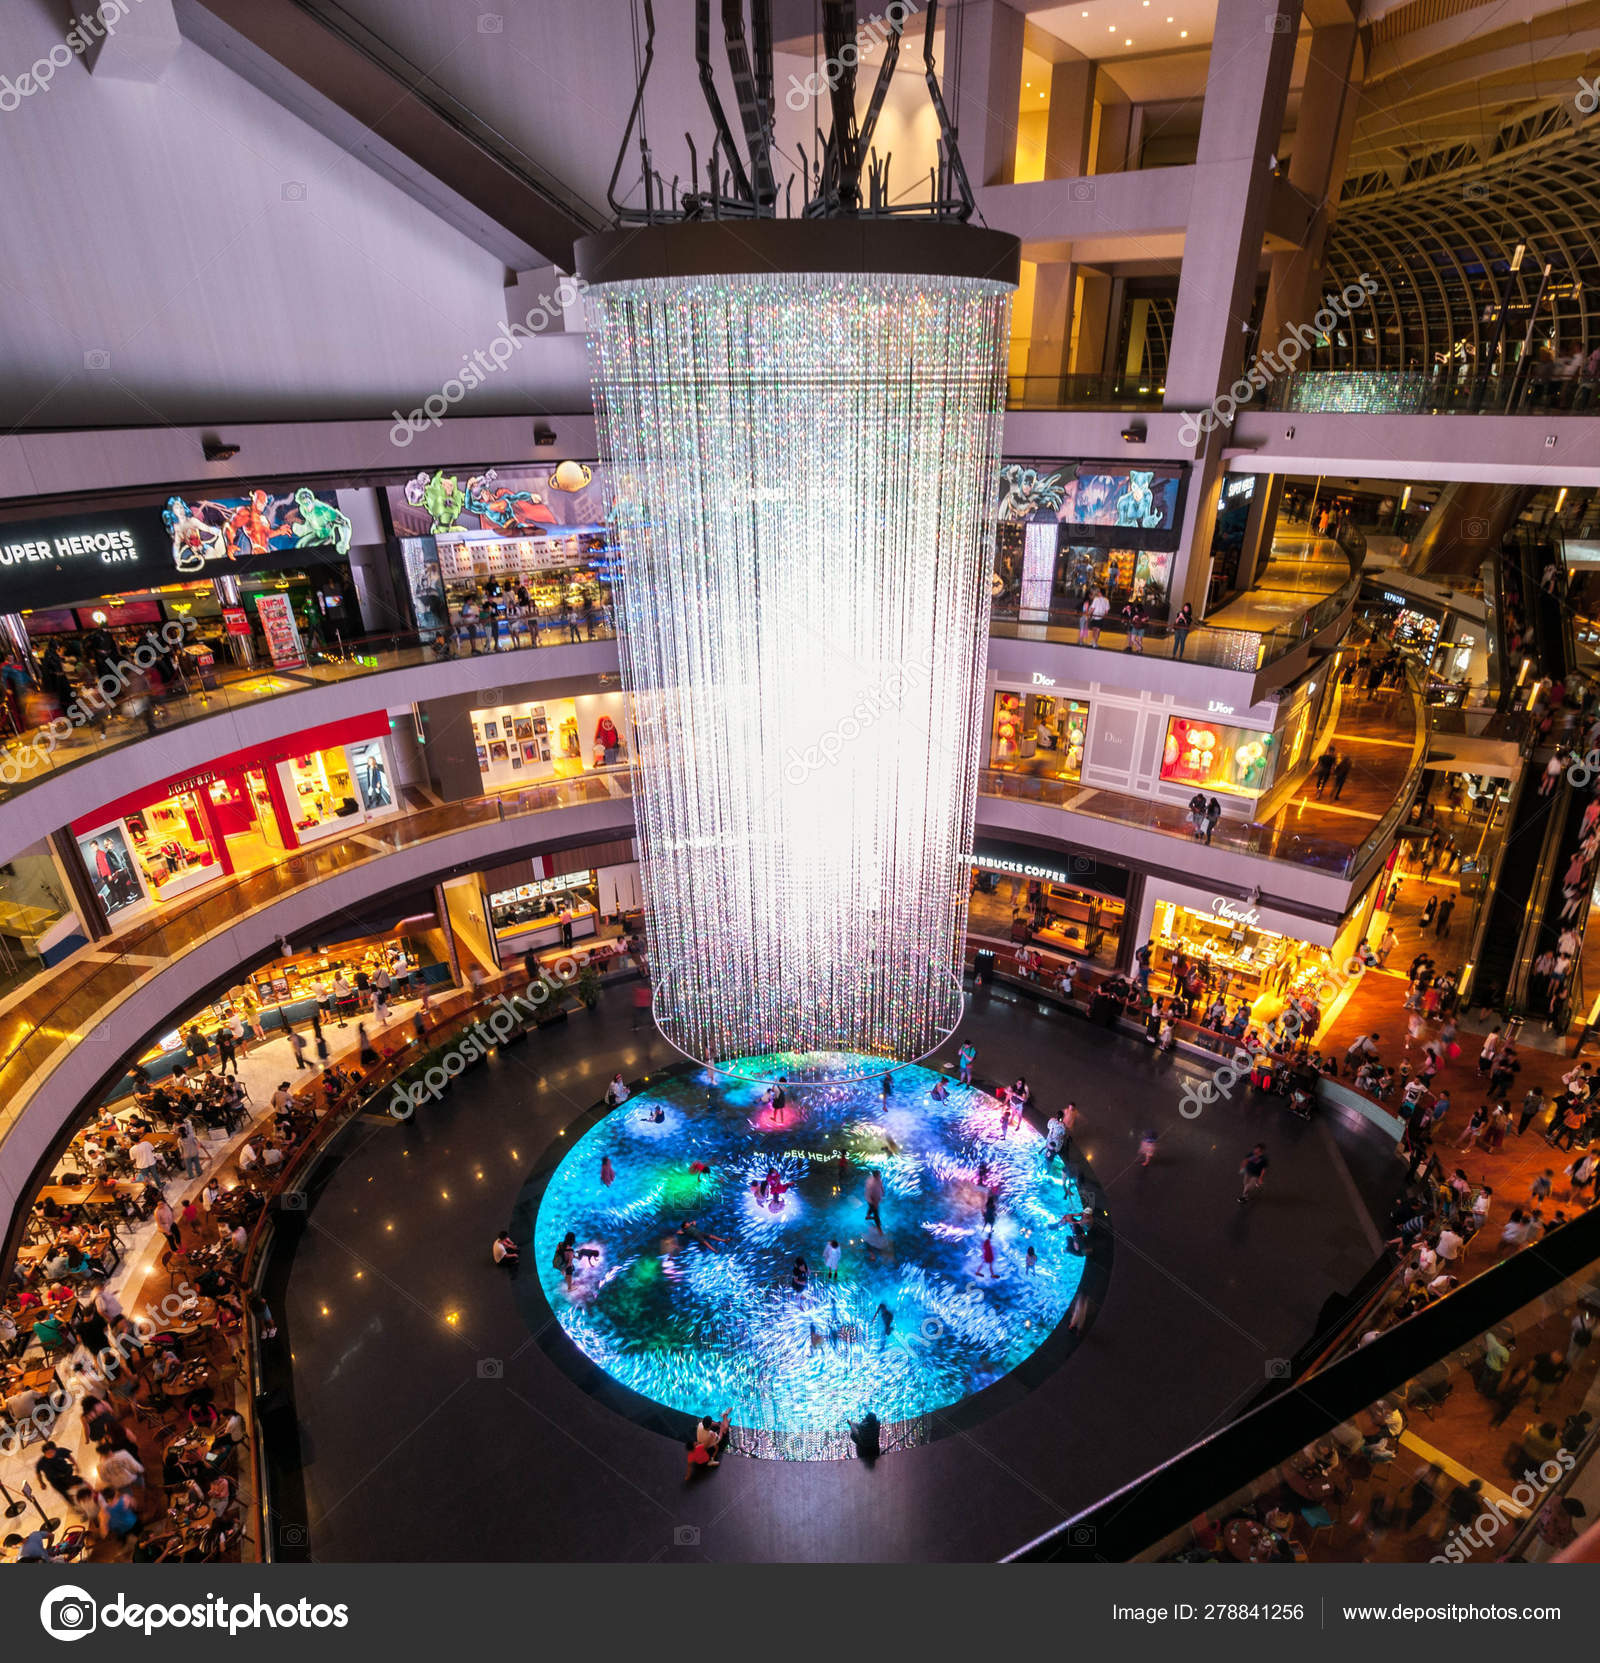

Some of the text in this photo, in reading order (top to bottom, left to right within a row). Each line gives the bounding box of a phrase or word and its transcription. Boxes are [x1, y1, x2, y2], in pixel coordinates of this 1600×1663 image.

[0, 530, 134, 565] UPER HEROES
[101, 547, 139, 563] CAFE
[1032, 672, 1056, 687] Dior
[1207, 700, 1235, 715] Dior
[1023, 865, 1066, 883] COFFEE
[1211, 897, 1263, 925] Venchi
